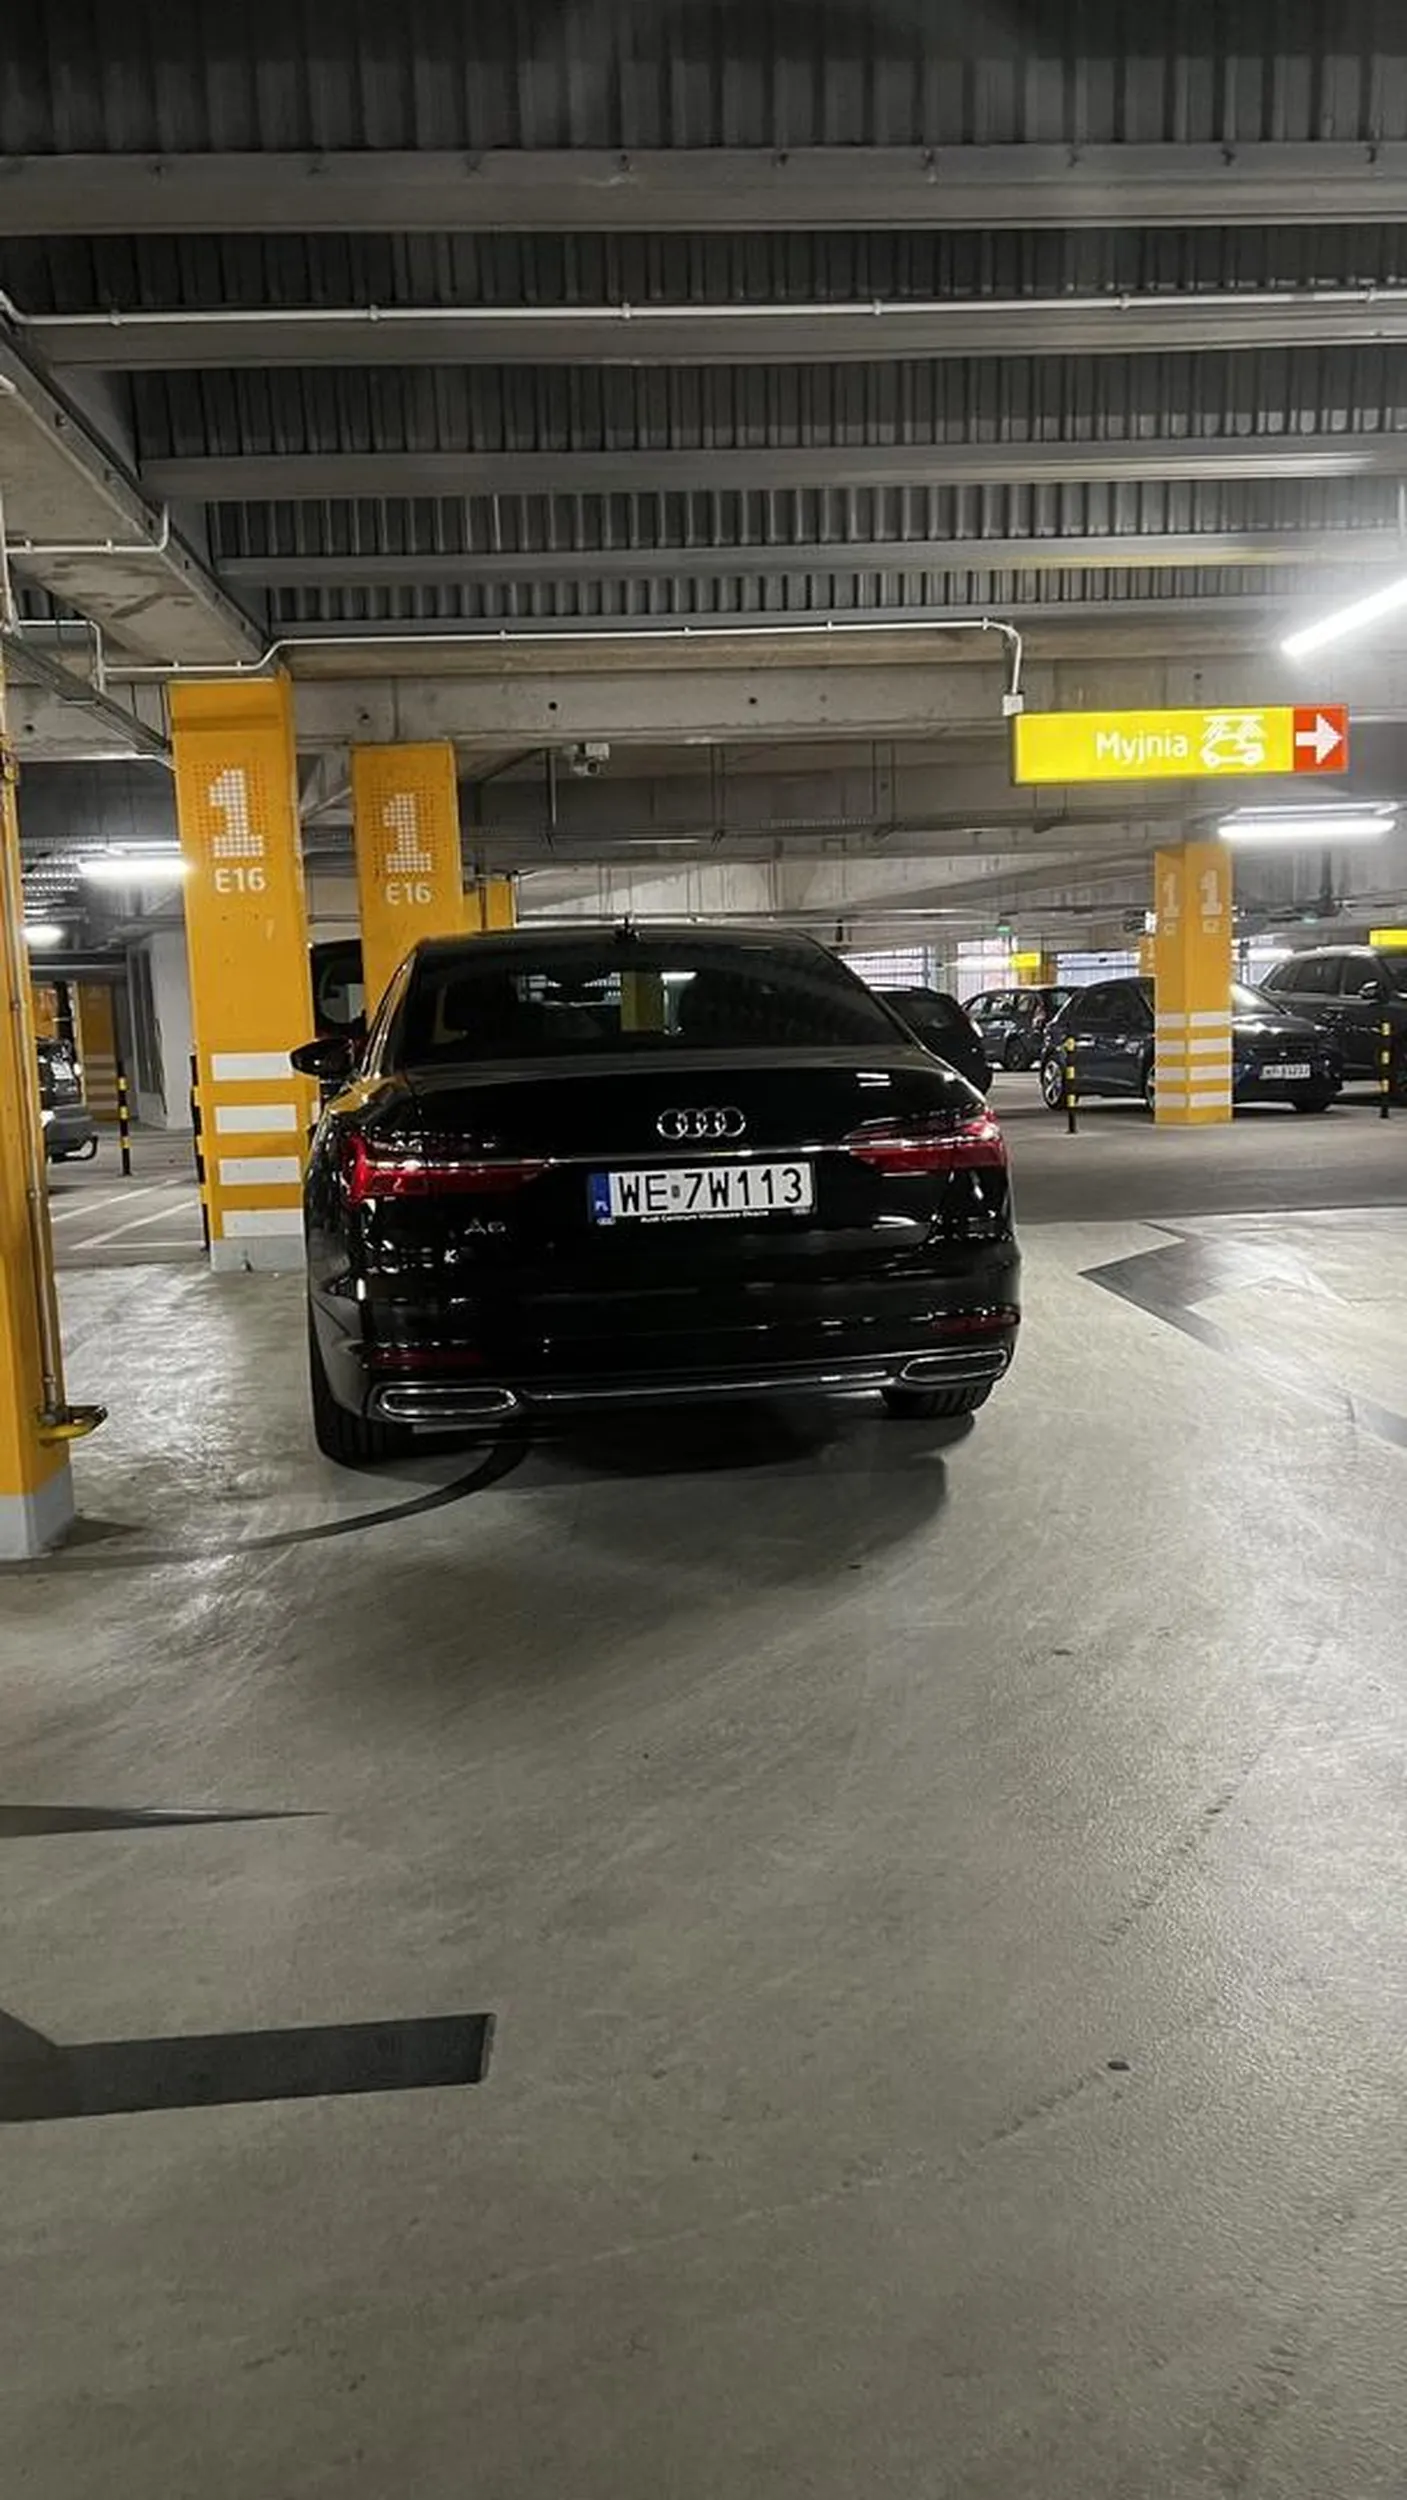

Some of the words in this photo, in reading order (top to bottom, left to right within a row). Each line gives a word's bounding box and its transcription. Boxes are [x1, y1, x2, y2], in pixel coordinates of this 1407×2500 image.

[1095, 729, 1189, 766] Myjnia
[207, 768, 265, 858] 1
[382, 792, 432, 873] 1
[214, 866, 267, 894] E16
[385, 881, 433, 906] E16
[1199, 868, 1223, 916] 1
[618, 1174, 669, 1213] WE
[683, 1167, 803, 1209] 7W113
